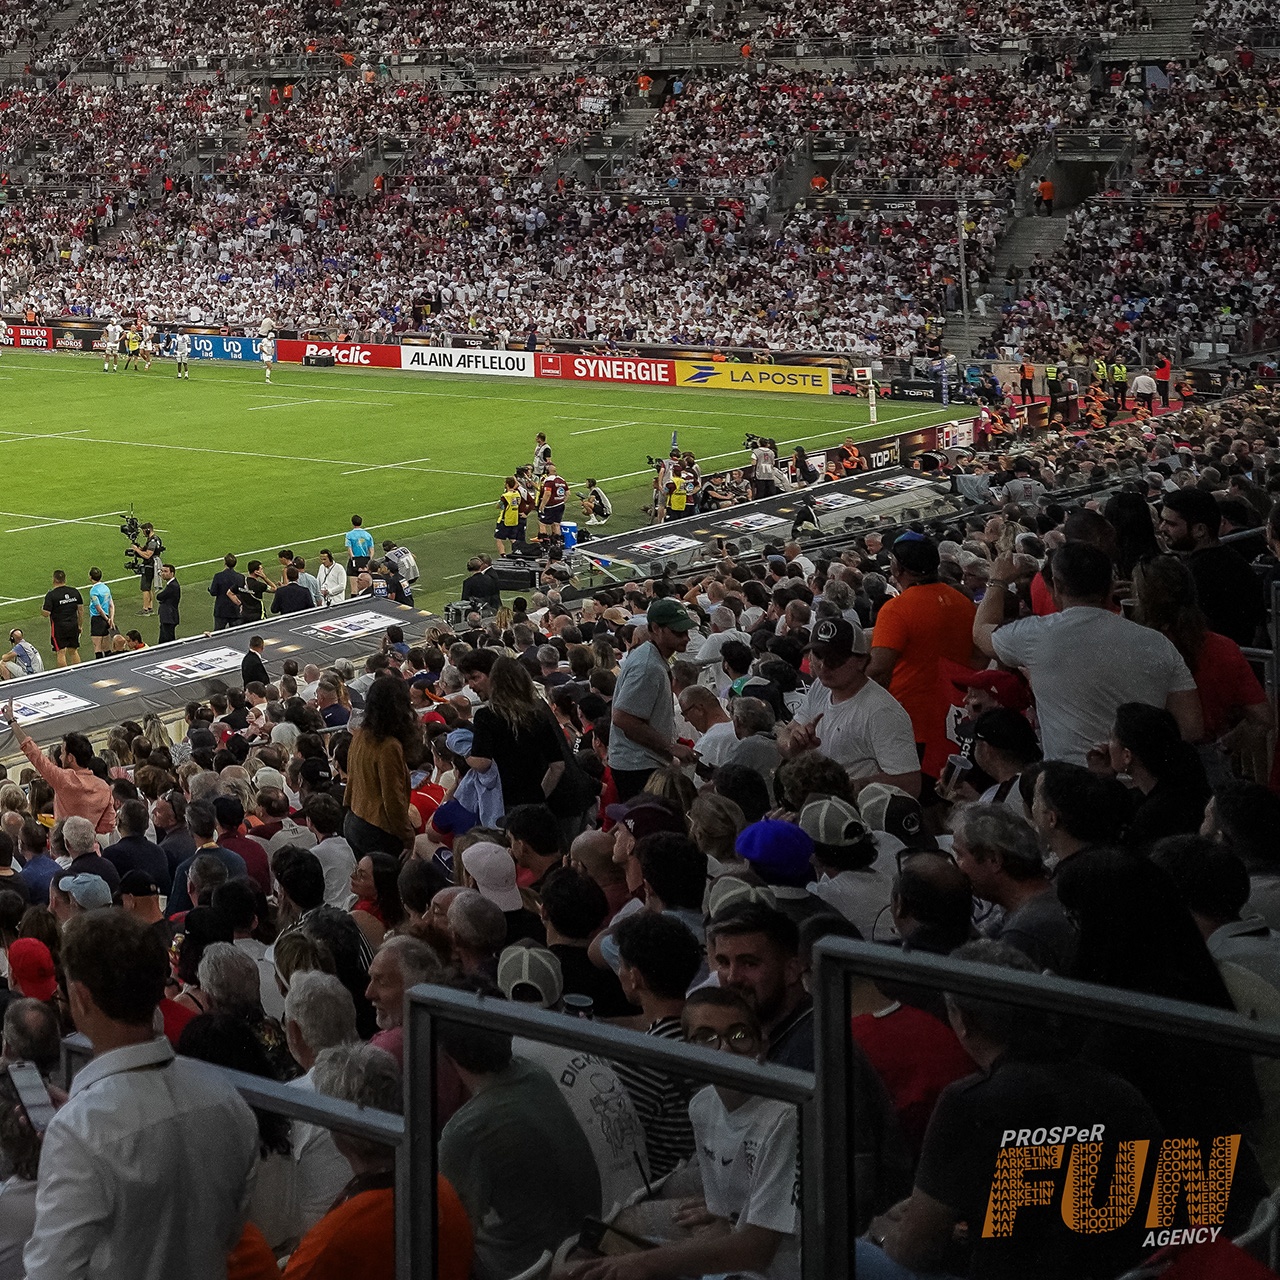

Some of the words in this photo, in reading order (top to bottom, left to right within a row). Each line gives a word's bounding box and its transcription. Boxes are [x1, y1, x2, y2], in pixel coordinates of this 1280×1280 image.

[20, 328, 47, 337] BRICO
[57, 340, 83, 348] ANDROS
[305, 345, 372, 365] Betclic
[410, 351, 453, 368] ALAIN
[456, 354, 526, 371] AFFLELOU
[574, 358, 670, 383] SYNERGIE
[730, 370, 755, 383] LA
[759, 371, 823, 387] POSTE
